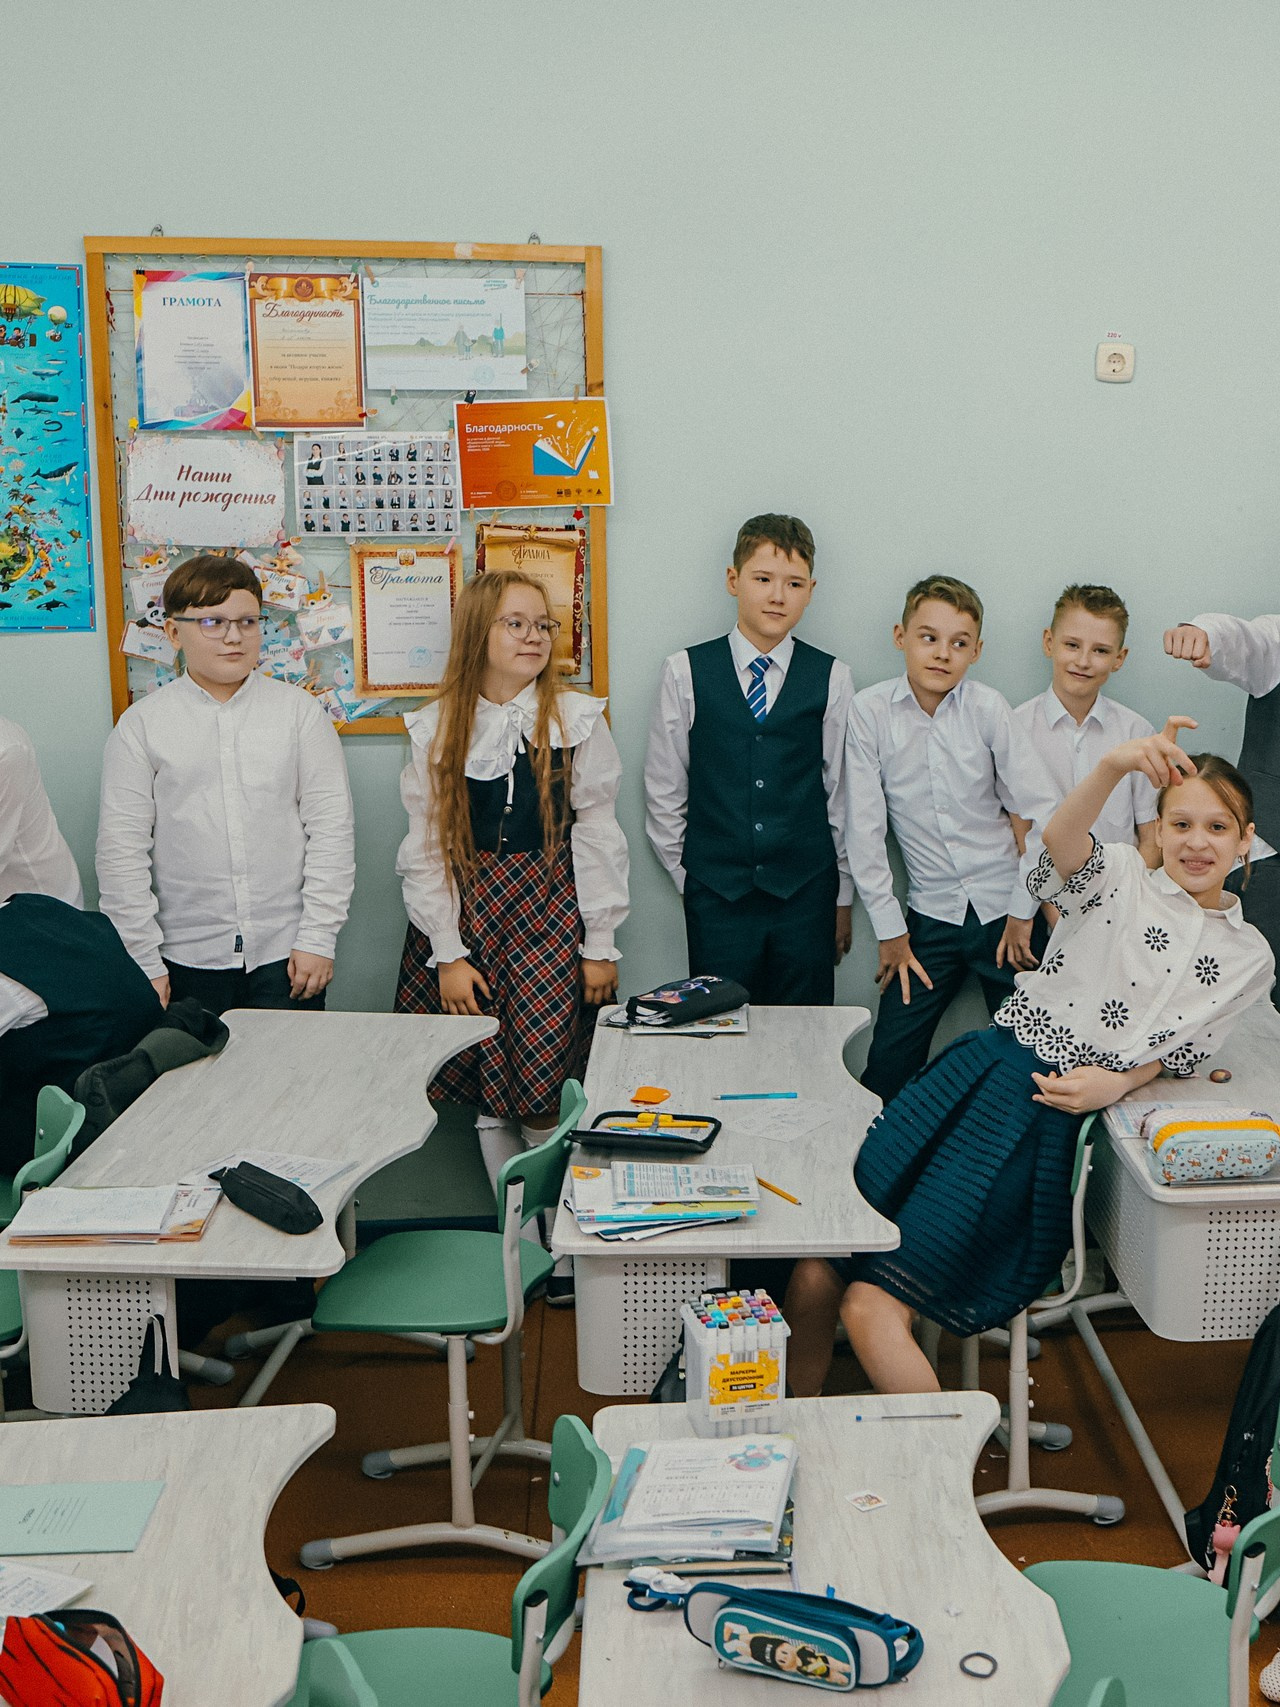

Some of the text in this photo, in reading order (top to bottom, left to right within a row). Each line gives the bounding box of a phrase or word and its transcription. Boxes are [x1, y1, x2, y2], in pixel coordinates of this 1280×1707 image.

[162, 297, 222, 307] ГРАМОТА
[367, 294, 486, 309] Благодарственное письмо
[262, 302, 344, 322] Благодарность
[465, 423, 543, 434] Благодарность
[177, 464, 233, 483] Наши
[133, 483, 277, 511] Дни рождения
[370, 566, 444, 590] Грамота
